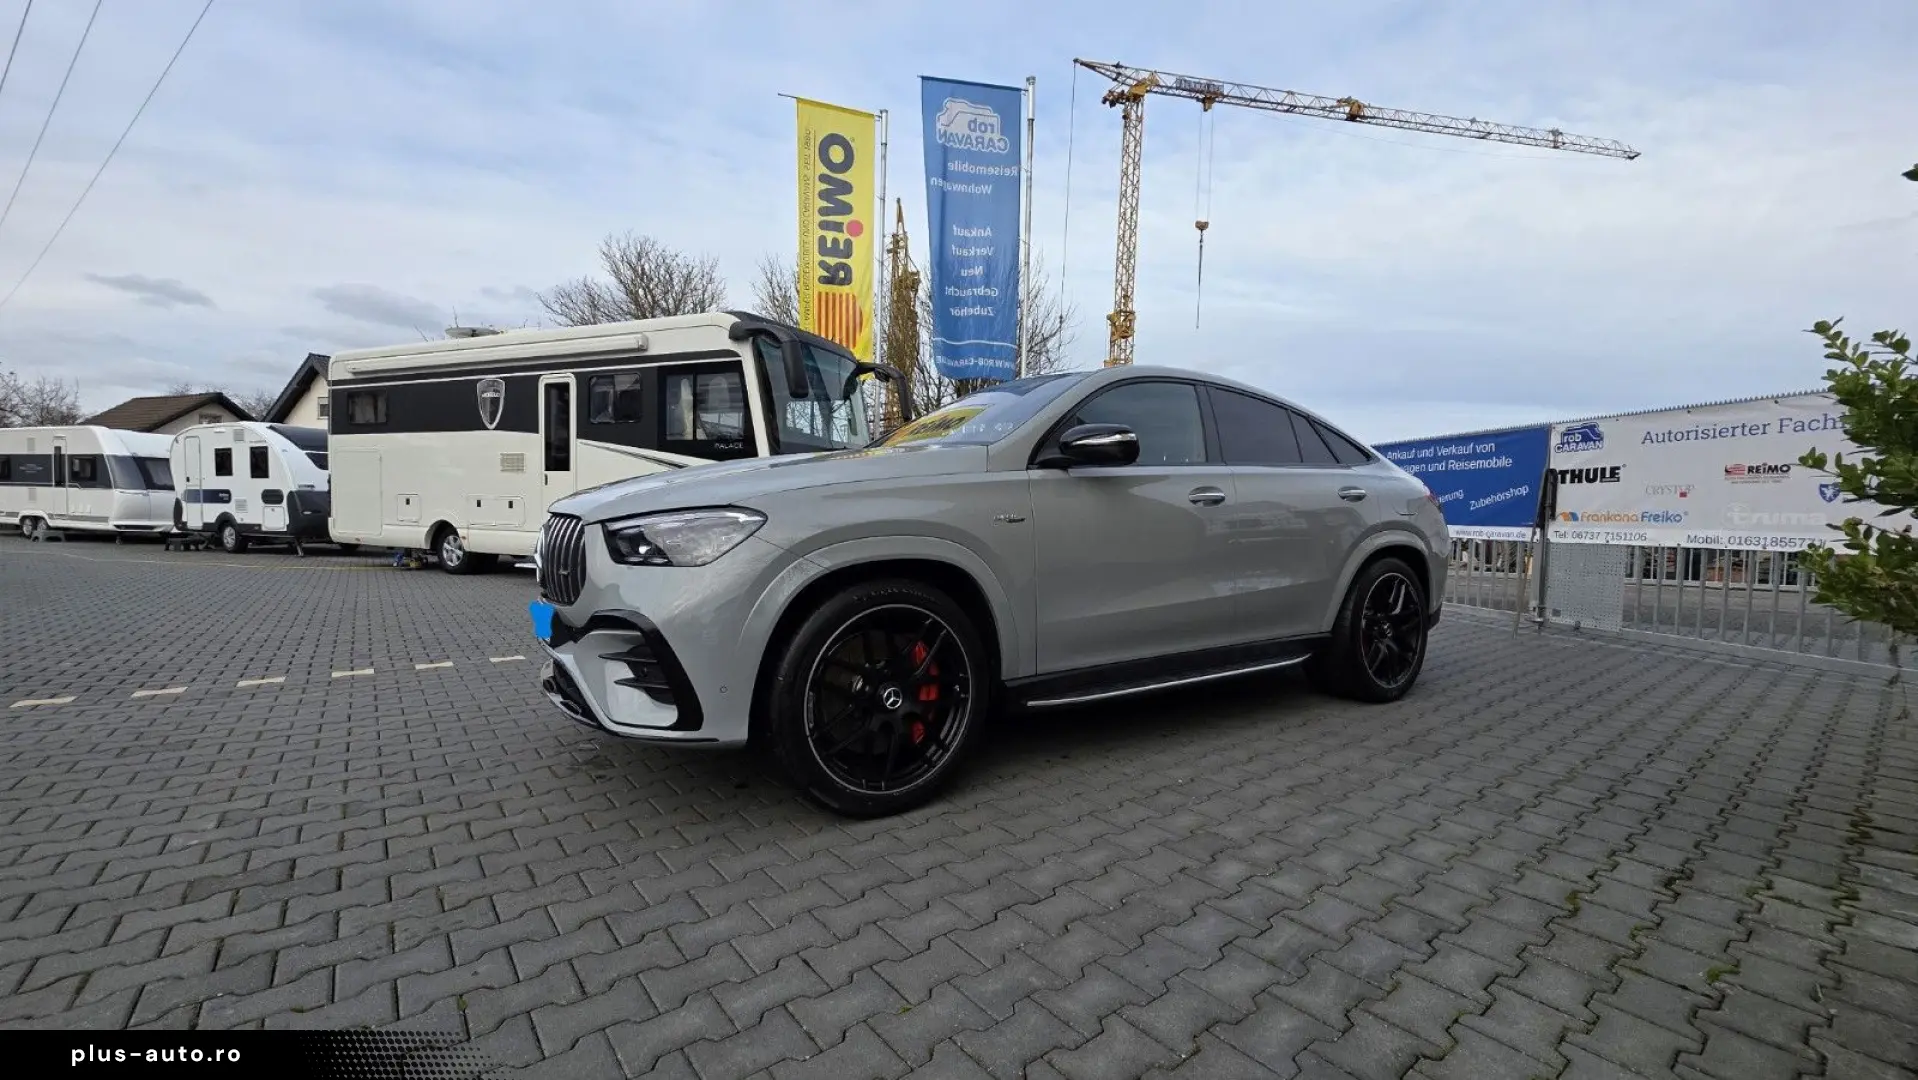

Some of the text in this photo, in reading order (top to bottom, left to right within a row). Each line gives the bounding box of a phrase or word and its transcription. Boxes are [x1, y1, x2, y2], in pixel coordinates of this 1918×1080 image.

[1563, 432, 1582, 443] rob
[1641, 421, 1771, 445] Autorisierter
[1386, 442, 1496, 461] Ankauf und Verkauf von
[1554, 440, 1604, 454] CARAVAN
[1428, 459, 1446, 472] und
[1447, 455, 1513, 471] Reisemobile
[1558, 466, 1621, 485] THULE
[1641, 510, 1684, 524] Freiko
[1728, 504, 1828, 526] truma
[1554, 530, 1569, 539] Tel:
[1571, 530, 1601, 540] 06737
[1603, 531, 1648, 542] 7151106
[1687, 533, 1724, 546] Mobil:
